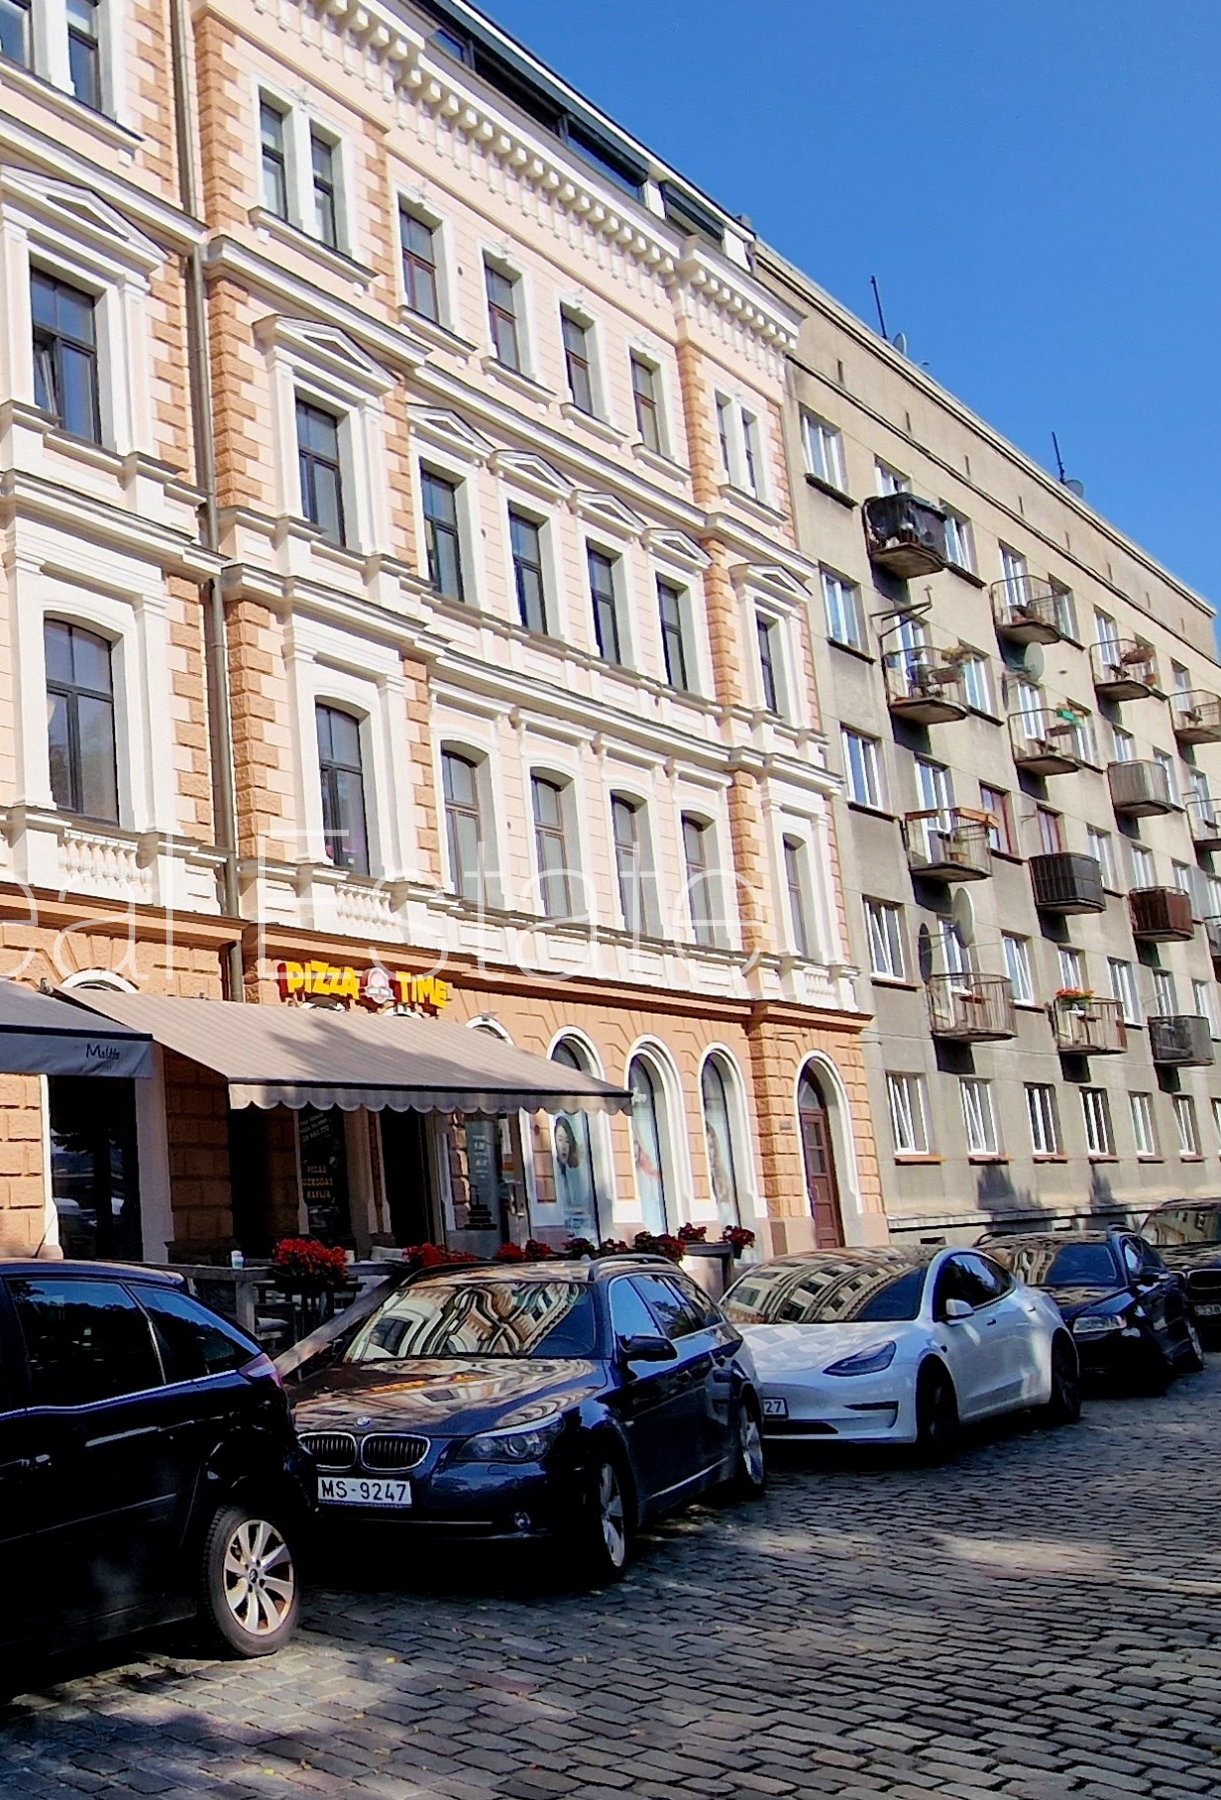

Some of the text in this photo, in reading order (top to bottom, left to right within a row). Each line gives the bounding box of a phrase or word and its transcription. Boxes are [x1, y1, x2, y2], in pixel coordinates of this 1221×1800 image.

[281, 960, 451, 1010] PIZZA TIME
[321, 1479, 406, 1502] MS-9247
